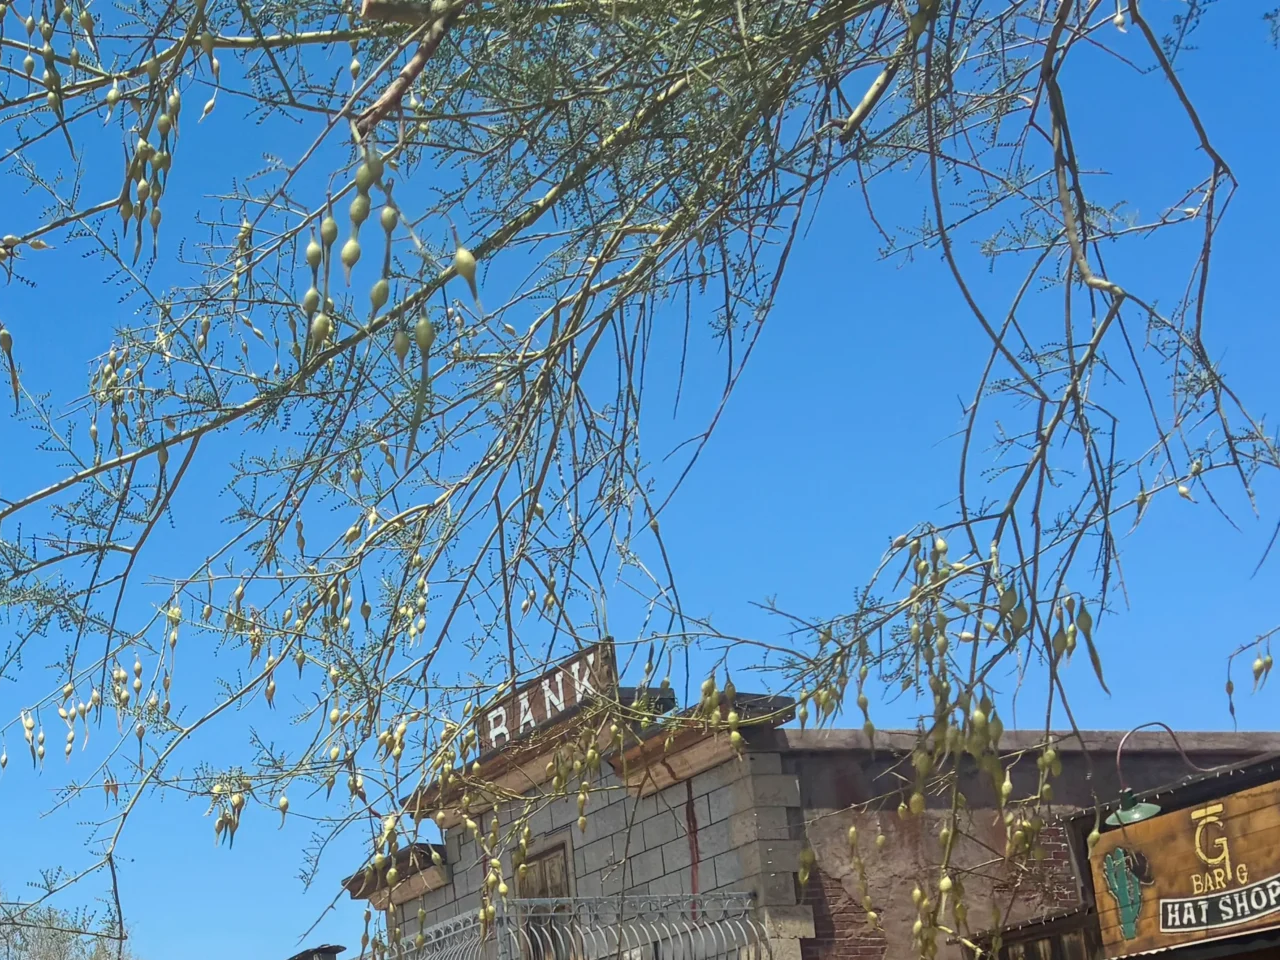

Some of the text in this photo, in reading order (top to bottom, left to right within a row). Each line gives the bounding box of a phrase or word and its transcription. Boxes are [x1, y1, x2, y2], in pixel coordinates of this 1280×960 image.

[487, 653, 595, 748] BANK
[1191, 864, 1249, 895] BAR G
[1167, 880, 1280, 926] HAT SHOP
